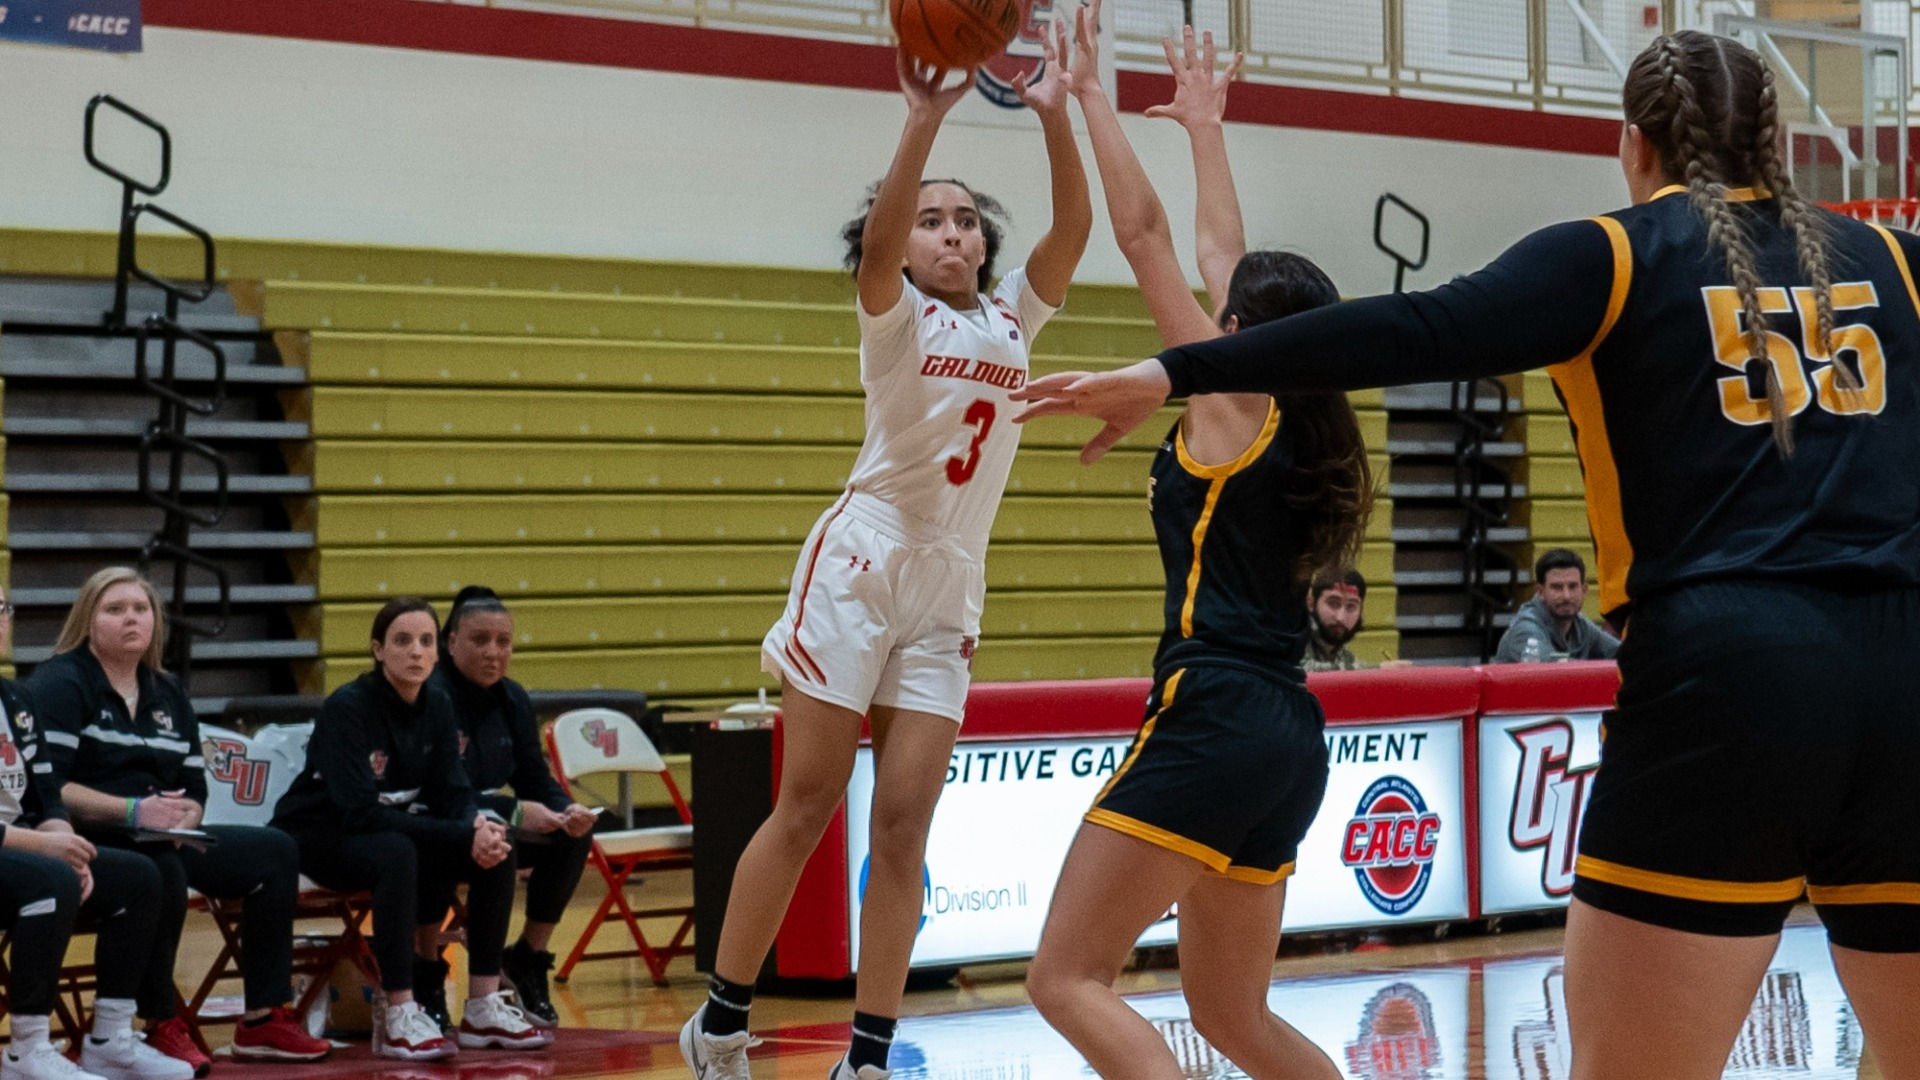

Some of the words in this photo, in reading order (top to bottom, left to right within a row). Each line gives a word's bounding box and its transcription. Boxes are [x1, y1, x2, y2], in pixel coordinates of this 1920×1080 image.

[1700, 280, 1887, 426] 55
[944, 397, 997, 488] 3
[1341, 812, 1441, 867] CACC
[935, 884, 1012, 914] Division
